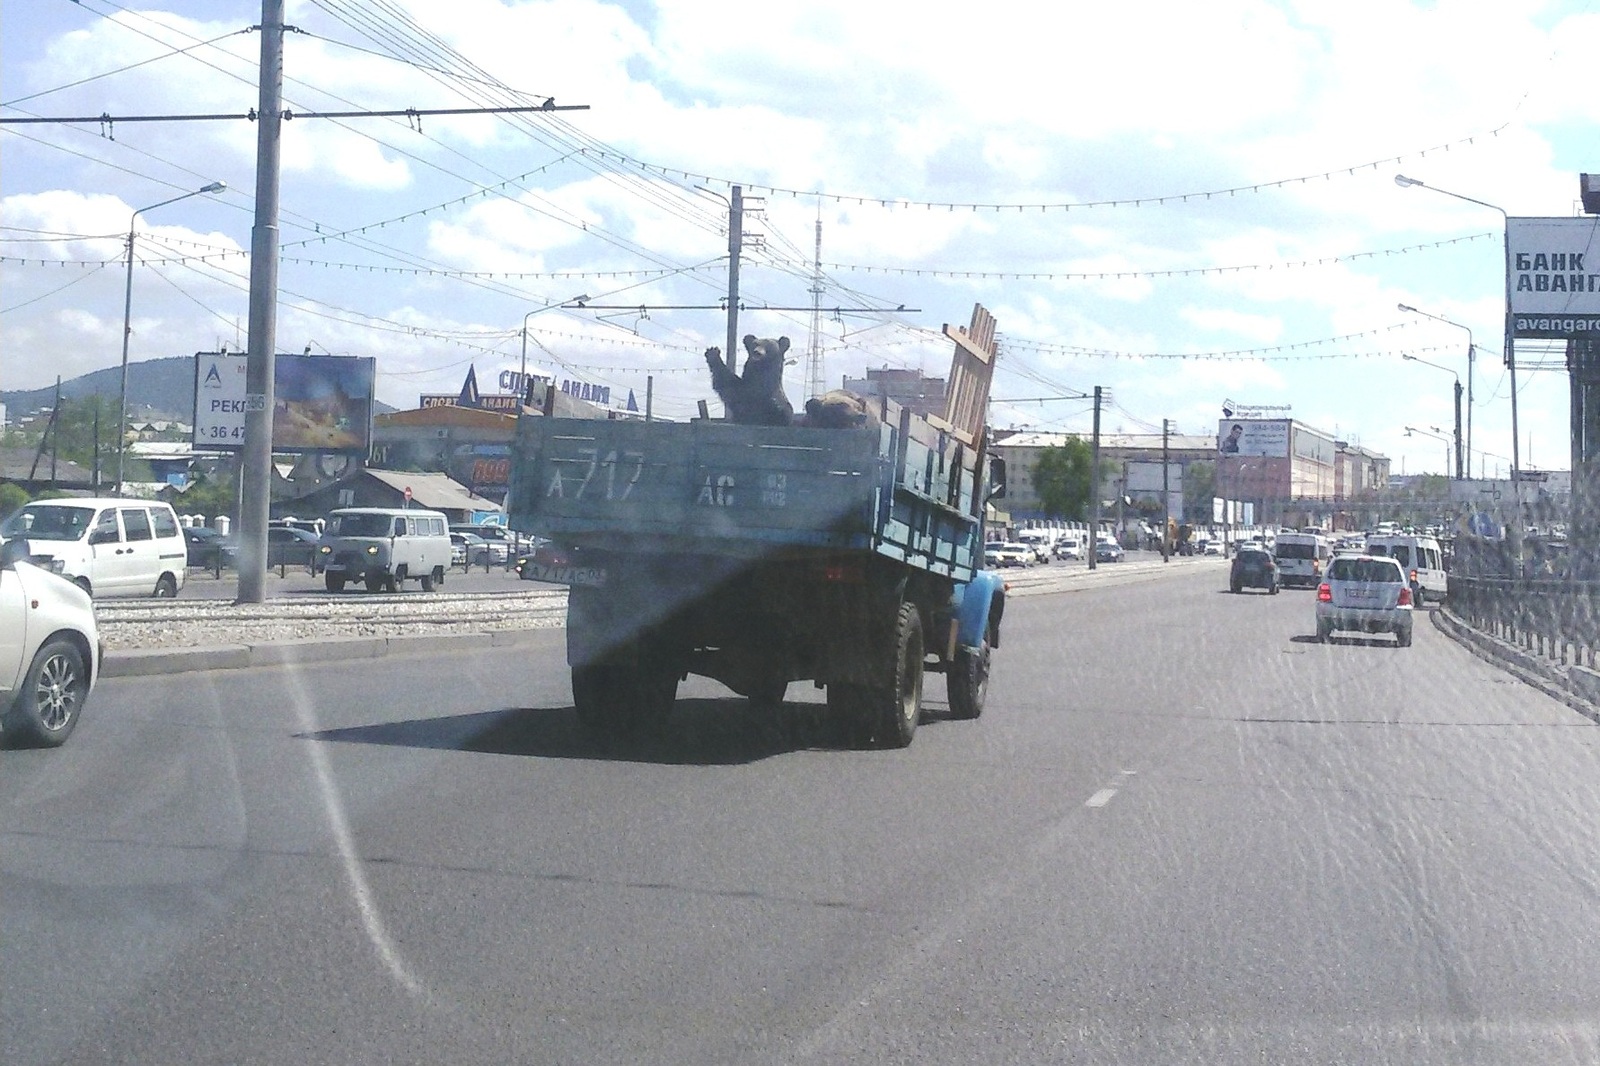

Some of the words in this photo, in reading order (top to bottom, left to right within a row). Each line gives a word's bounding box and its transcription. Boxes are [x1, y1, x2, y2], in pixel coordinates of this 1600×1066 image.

[1516, 253, 1584, 271] БАНК
[1517, 274, 1600, 292] АВАНГ
[211, 426, 227, 439] 36
[577, 448, 644, 501] 717
